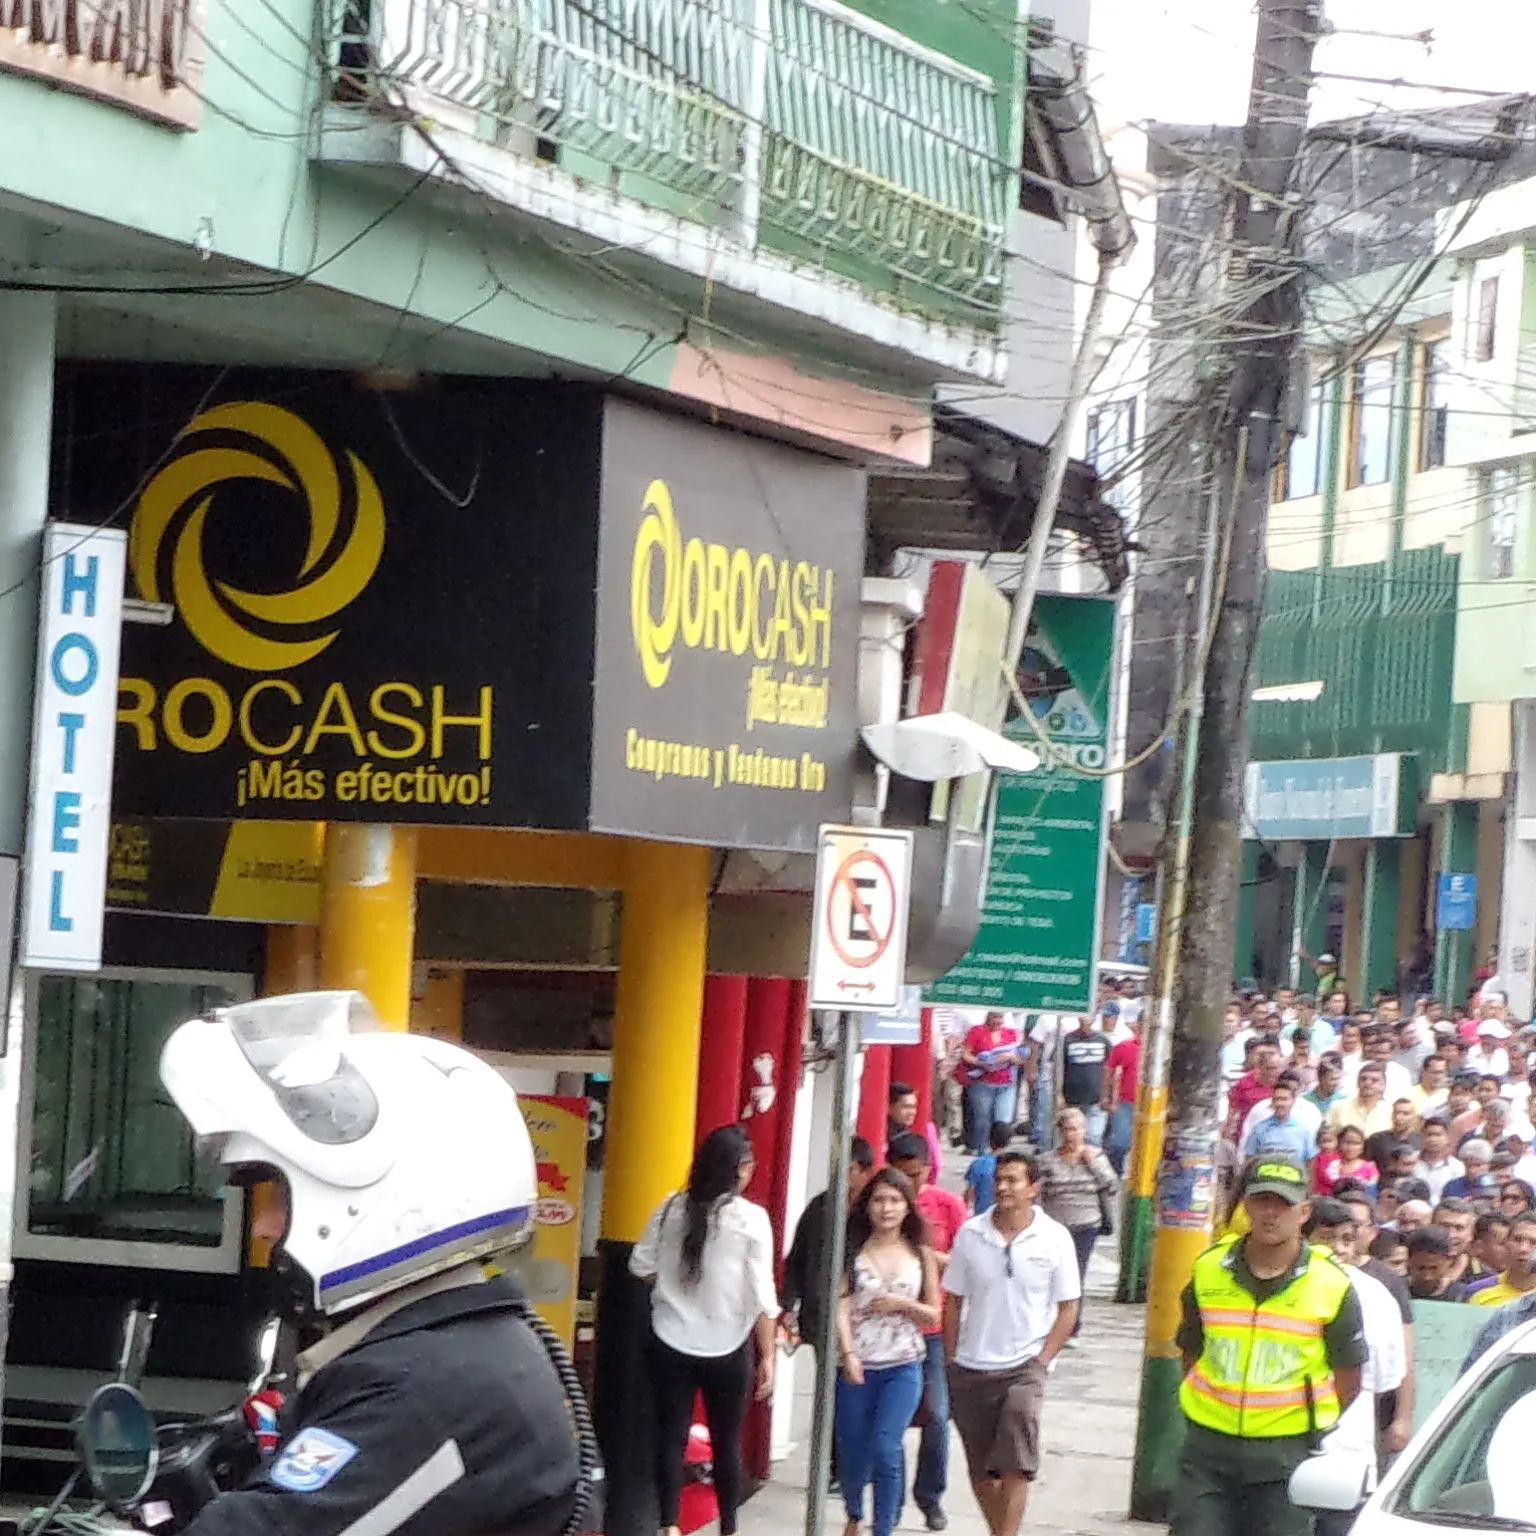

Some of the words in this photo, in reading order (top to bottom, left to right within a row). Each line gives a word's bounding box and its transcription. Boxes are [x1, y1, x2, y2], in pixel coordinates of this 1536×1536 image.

[681, 537, 834, 669] OROCASH
[50, 553, 100, 932] HOTEL
[116, 677, 494, 760] ROCASH
[237, 760, 325, 807] ¡Más
[336, 762, 491, 806] efectivo!
